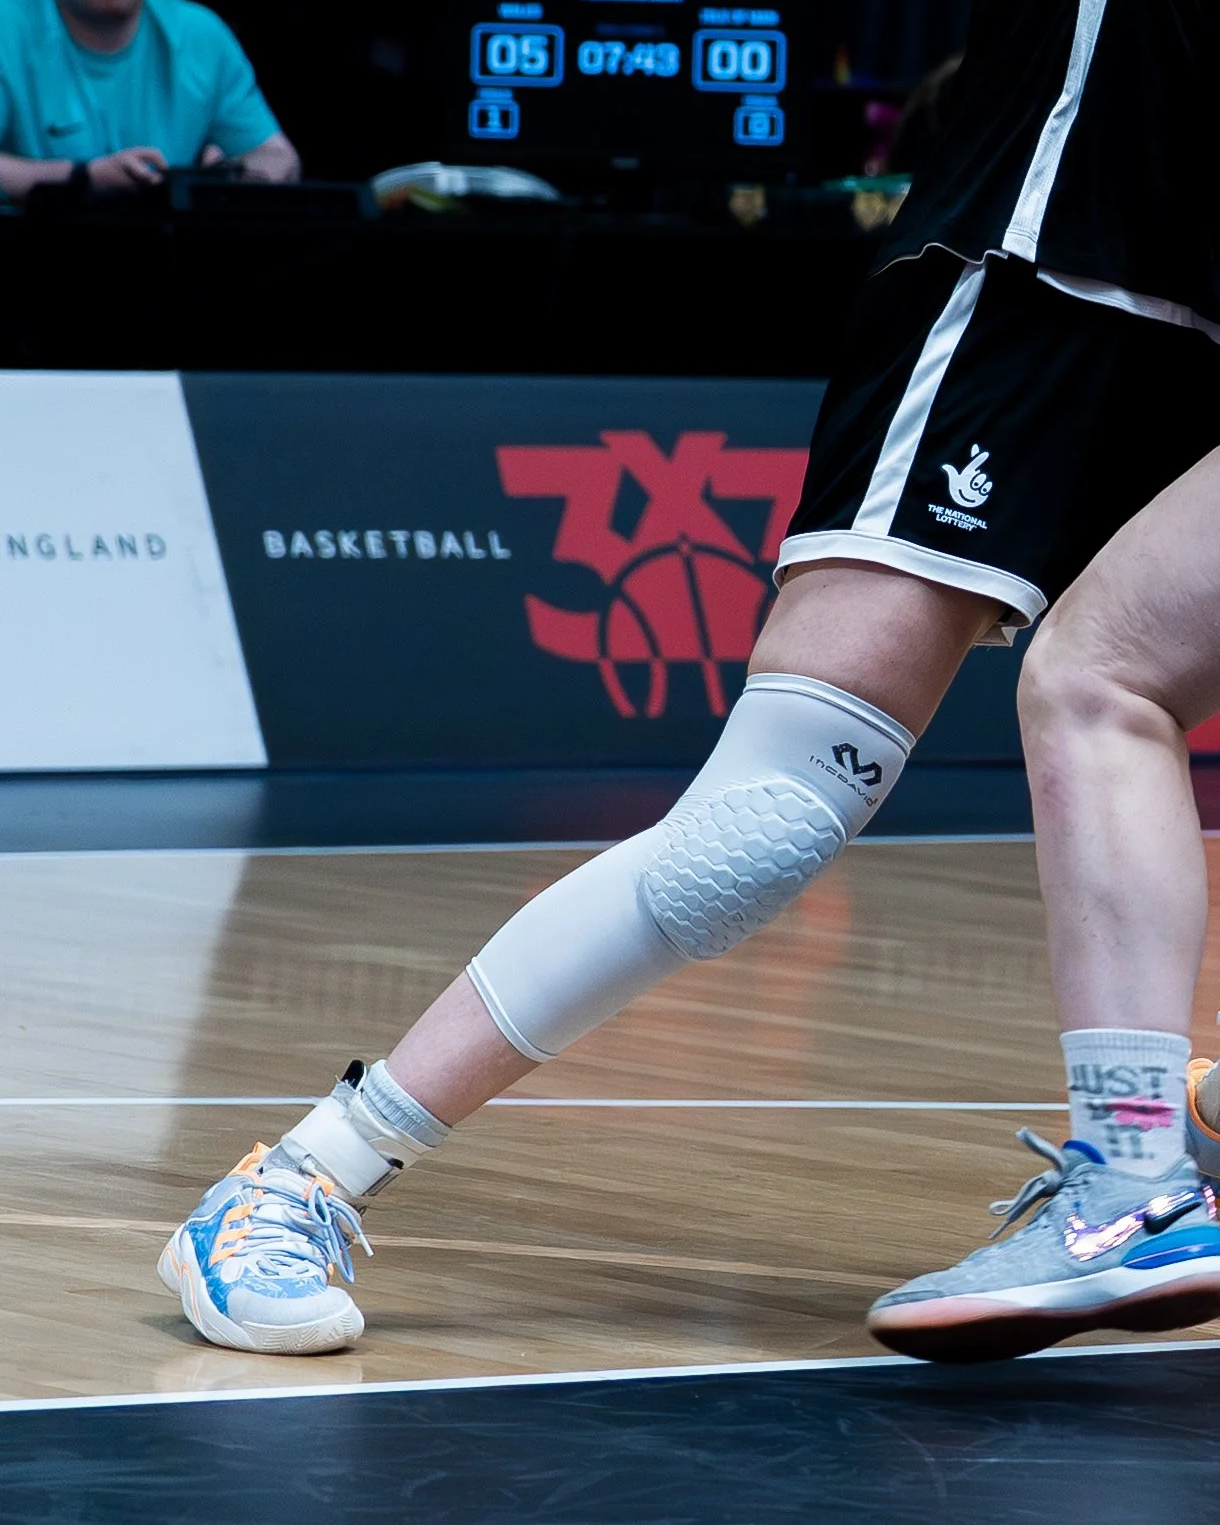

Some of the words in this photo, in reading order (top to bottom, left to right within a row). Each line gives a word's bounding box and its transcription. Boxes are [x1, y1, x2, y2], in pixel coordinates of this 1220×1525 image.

[486, 33, 550, 76] 05
[707, 40, 772, 81] 00
[928, 503, 945, 515] THE
[945, 508, 988, 529] NATIONAL
[935, 513, 975, 532] LOTTERY
[264, 529, 511, 560] BASKETBALL
